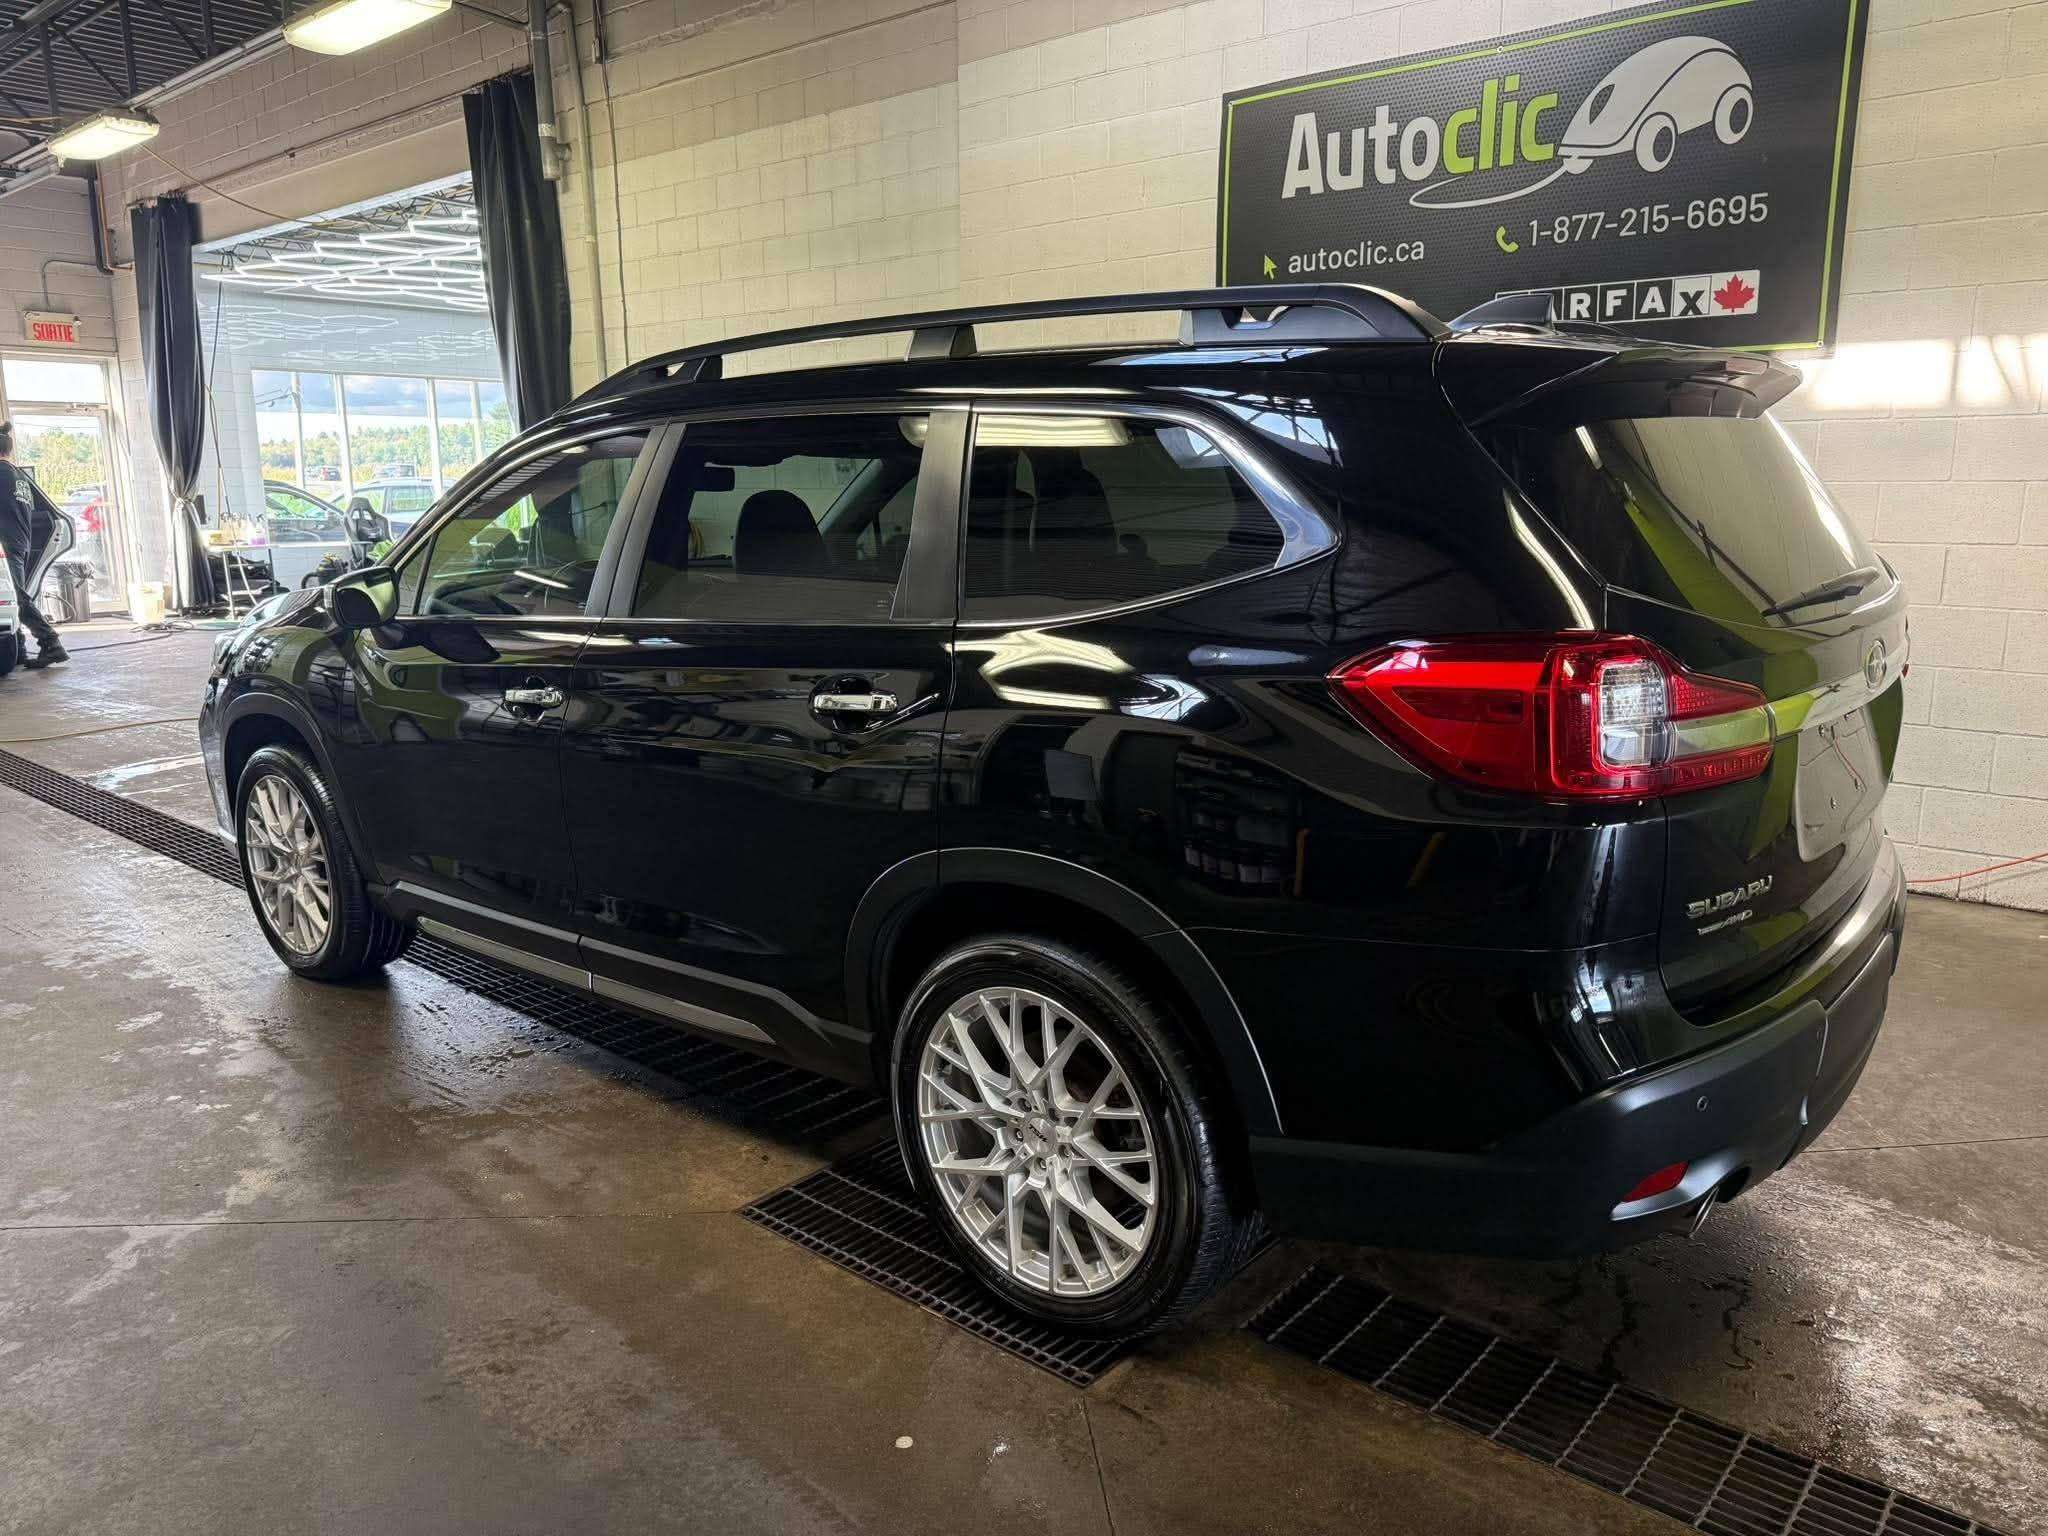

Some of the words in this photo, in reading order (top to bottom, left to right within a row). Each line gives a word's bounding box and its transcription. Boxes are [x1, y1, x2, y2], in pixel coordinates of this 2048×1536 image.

[1281, 74, 1559, 199] Autoclic
[1529, 192, 1769, 247] 1-877-215-6695
[1287, 239, 1425, 274] autoclic.ca
[1551, 286, 1706, 321] RFAX
[32, 322, 74, 342] SORTIE
[1687, 874, 1773, 918] SUBARU
